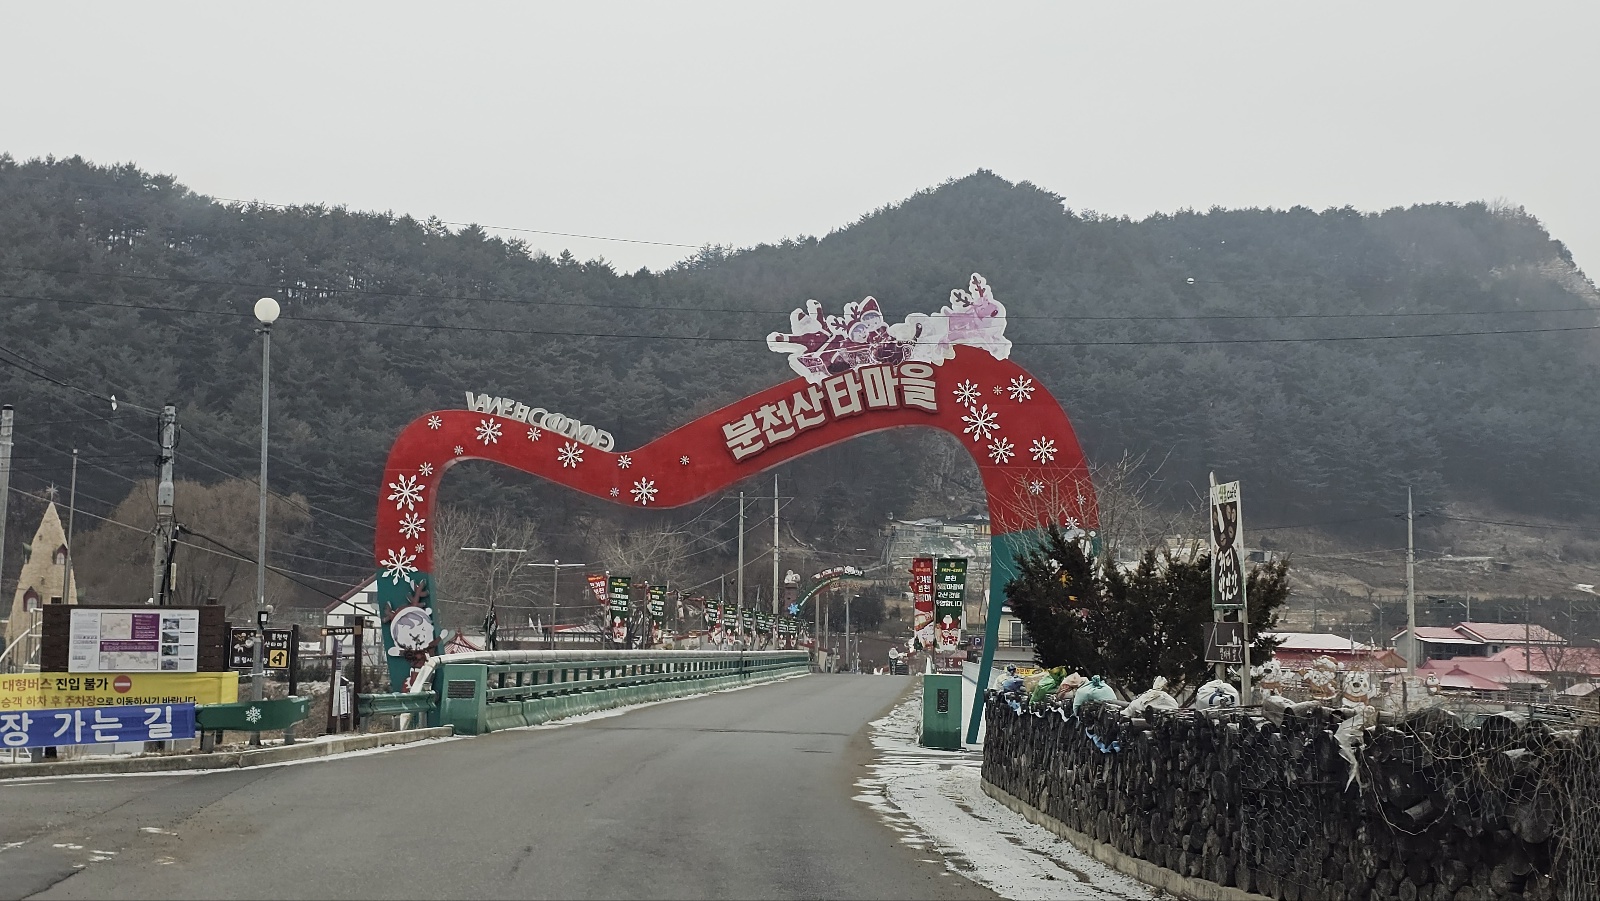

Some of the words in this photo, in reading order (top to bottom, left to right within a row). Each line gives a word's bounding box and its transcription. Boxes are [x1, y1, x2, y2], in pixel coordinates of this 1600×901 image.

[465, 391, 615, 452] WELCOME
[722, 363, 938, 461] 분천산타마을
[1217, 547, 1234, 577] 커피
[0, 696, 23, 709] 승객
[26, 695, 47, 707] 하차
[50, 695, 63, 707] 후
[64, 695, 114, 707] 주차장으로
[116, 696, 160, 706] 이동하시기
[2, 677, 53, 692] 대형버스
[56, 677, 81, 692] 진입
[84, 677, 109, 692] 불가
[0, 712, 34, 746] 장
[53, 709, 123, 743] 가는
[144, 705, 173, 739] 길
